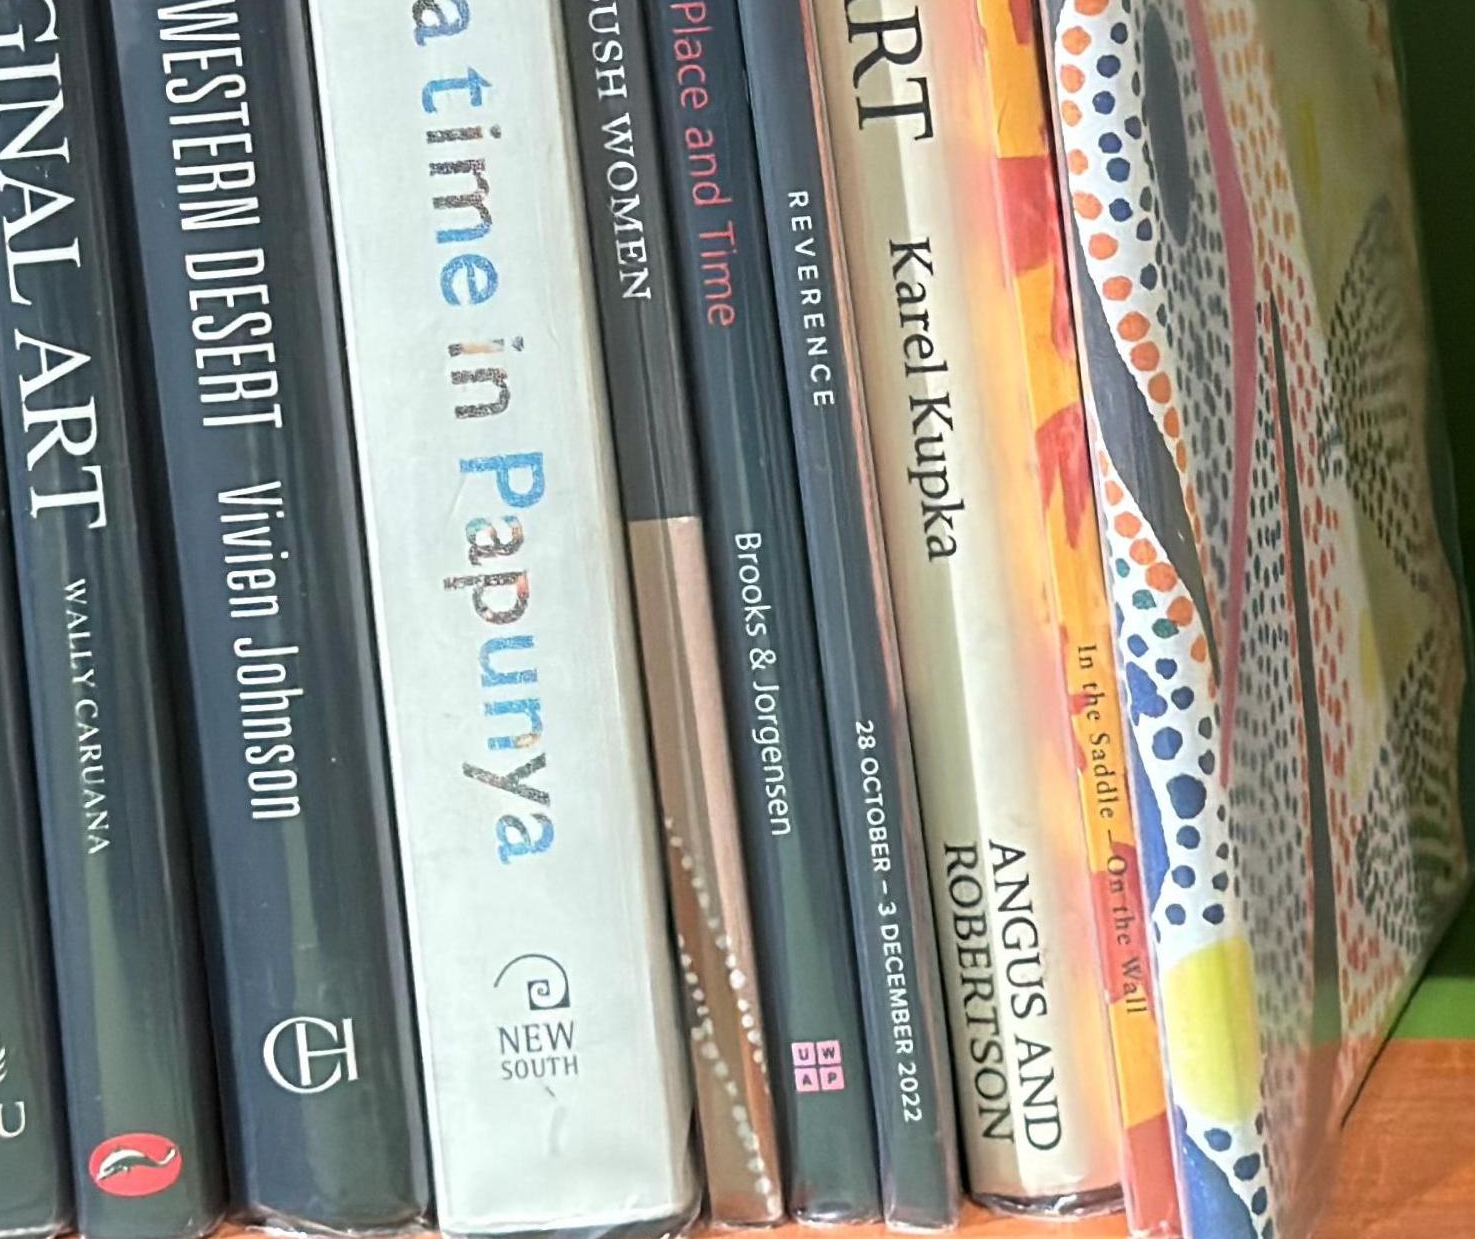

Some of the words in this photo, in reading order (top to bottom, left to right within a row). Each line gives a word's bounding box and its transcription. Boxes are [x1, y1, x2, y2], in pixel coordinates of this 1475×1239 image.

[670, 0, 717, 110] Place
[421, 67, 501, 307] time
[599, 112, 651, 301] WOMEN
[685, 126, 732, 206] and
[698, 219, 737, 328] Time
[787, 190, 835, 407] REVERENCE
[888, 237, 949, 378] Karel
[185, 248, 283, 429] DESERT
[448, 336, 525, 420] in
[14, 328, 108, 530] ART
[907, 392, 965, 562] Kupka
[218, 480, 289, 619] Vivien
[734, 532, 778, 638] Brooks
[63, 578, 96, 688] WALLY
[444, 451, 554, 865] Papunya
[748, 648, 777, 671] &
[1077, 644, 1098, 668] In
[234, 638, 304, 820] Johnson
[855, 720, 875, 750] 28
[1083, 682, 1106, 719] the
[74, 700, 110, 855] CARUANA
[751, 680, 792, 837] Jorgensen
[1089, 732, 1121, 820] Saddle
[860, 757, 892, 872] OCTOBER
[877, 901, 897, 917] 3
[1106, 854, 1127, 891] On
[1109, 900, 1130, 945] the
[989, 839, 1048, 1020] ANGUS
[498, 1020, 575, 1054] NEW
[881, 924, 914, 1056] DECEMBER
[944, 841, 1014, 1144] ROBERTSON
[1121, 957, 1147, 1015] Wall
[500, 1054, 579, 1080] SOUTH
[897, 1062, 922, 1124] 2022
[1015, 1035, 1064, 1151] AND
